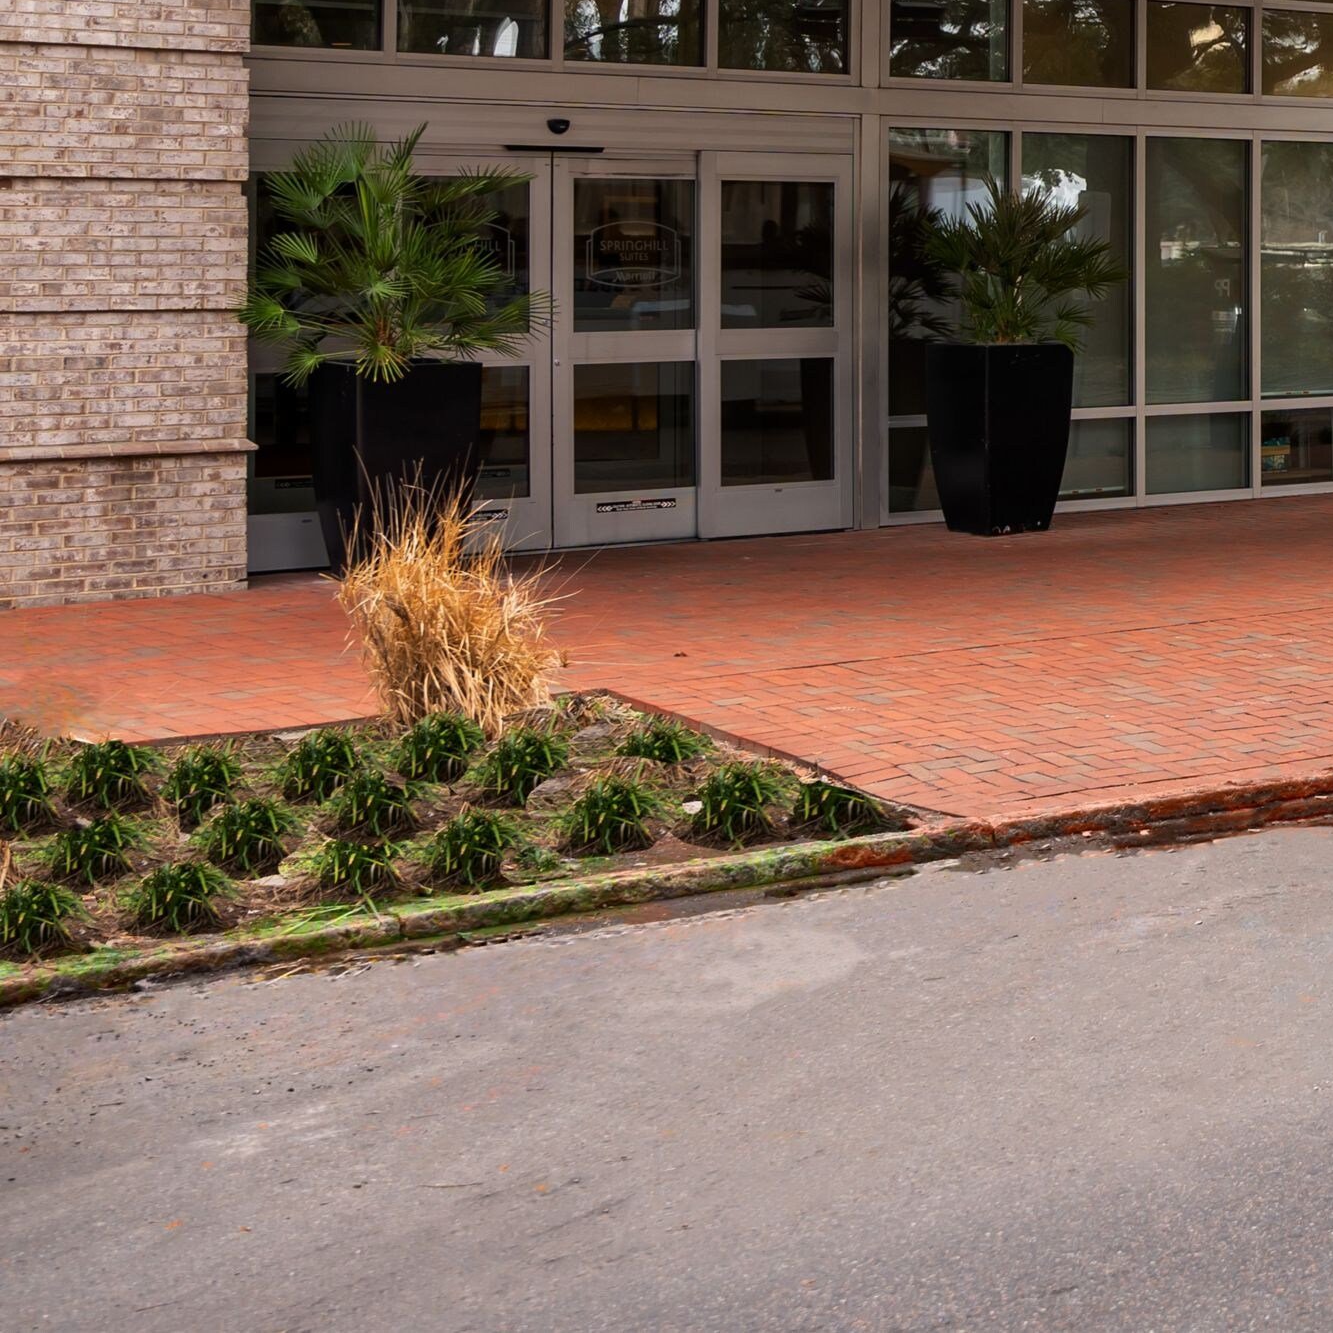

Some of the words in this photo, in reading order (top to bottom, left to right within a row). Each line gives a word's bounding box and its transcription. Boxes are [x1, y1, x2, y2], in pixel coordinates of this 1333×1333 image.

[600, 240, 669, 251] SPRINGHILL
[619, 252, 649, 261] SUITES
[612, 270, 655, 282] Marriott
